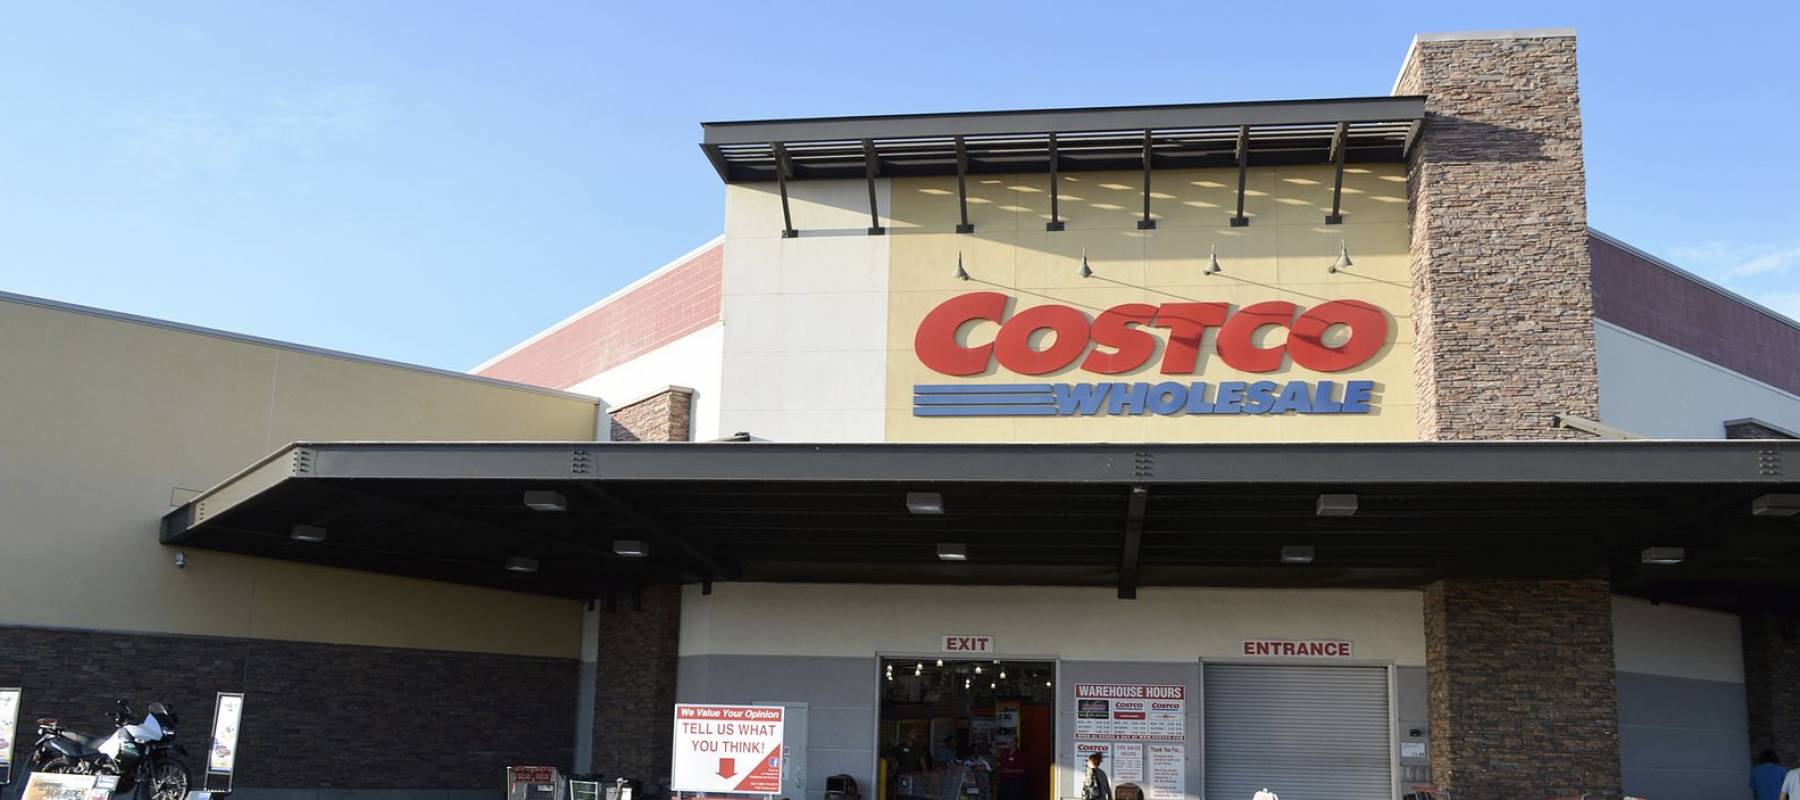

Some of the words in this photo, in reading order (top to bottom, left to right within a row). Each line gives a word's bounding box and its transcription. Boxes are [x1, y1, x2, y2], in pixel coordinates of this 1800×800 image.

[914, 291, 1388, 376] COSTCO
[1055, 380, 1375, 415] WHOLESALE
[946, 637, 989, 651] EXIT
[1244, 641, 1350, 656] ENTRANCE
[1079, 686, 1143, 697] WAREHOUSE
[1146, 687, 1181, 698] HOURS
[681, 708, 694, 717] We
[697, 708, 720, 717] Value
[722, 709, 743, 718] Your
[745, 709, 779, 719] Opinion
[682, 722, 713, 735] TELL
[717, 723, 734, 735] US
[738, 724, 776, 736] WHAT
[692, 740, 718, 752] YOU
[722, 741, 765, 753] THINK!
